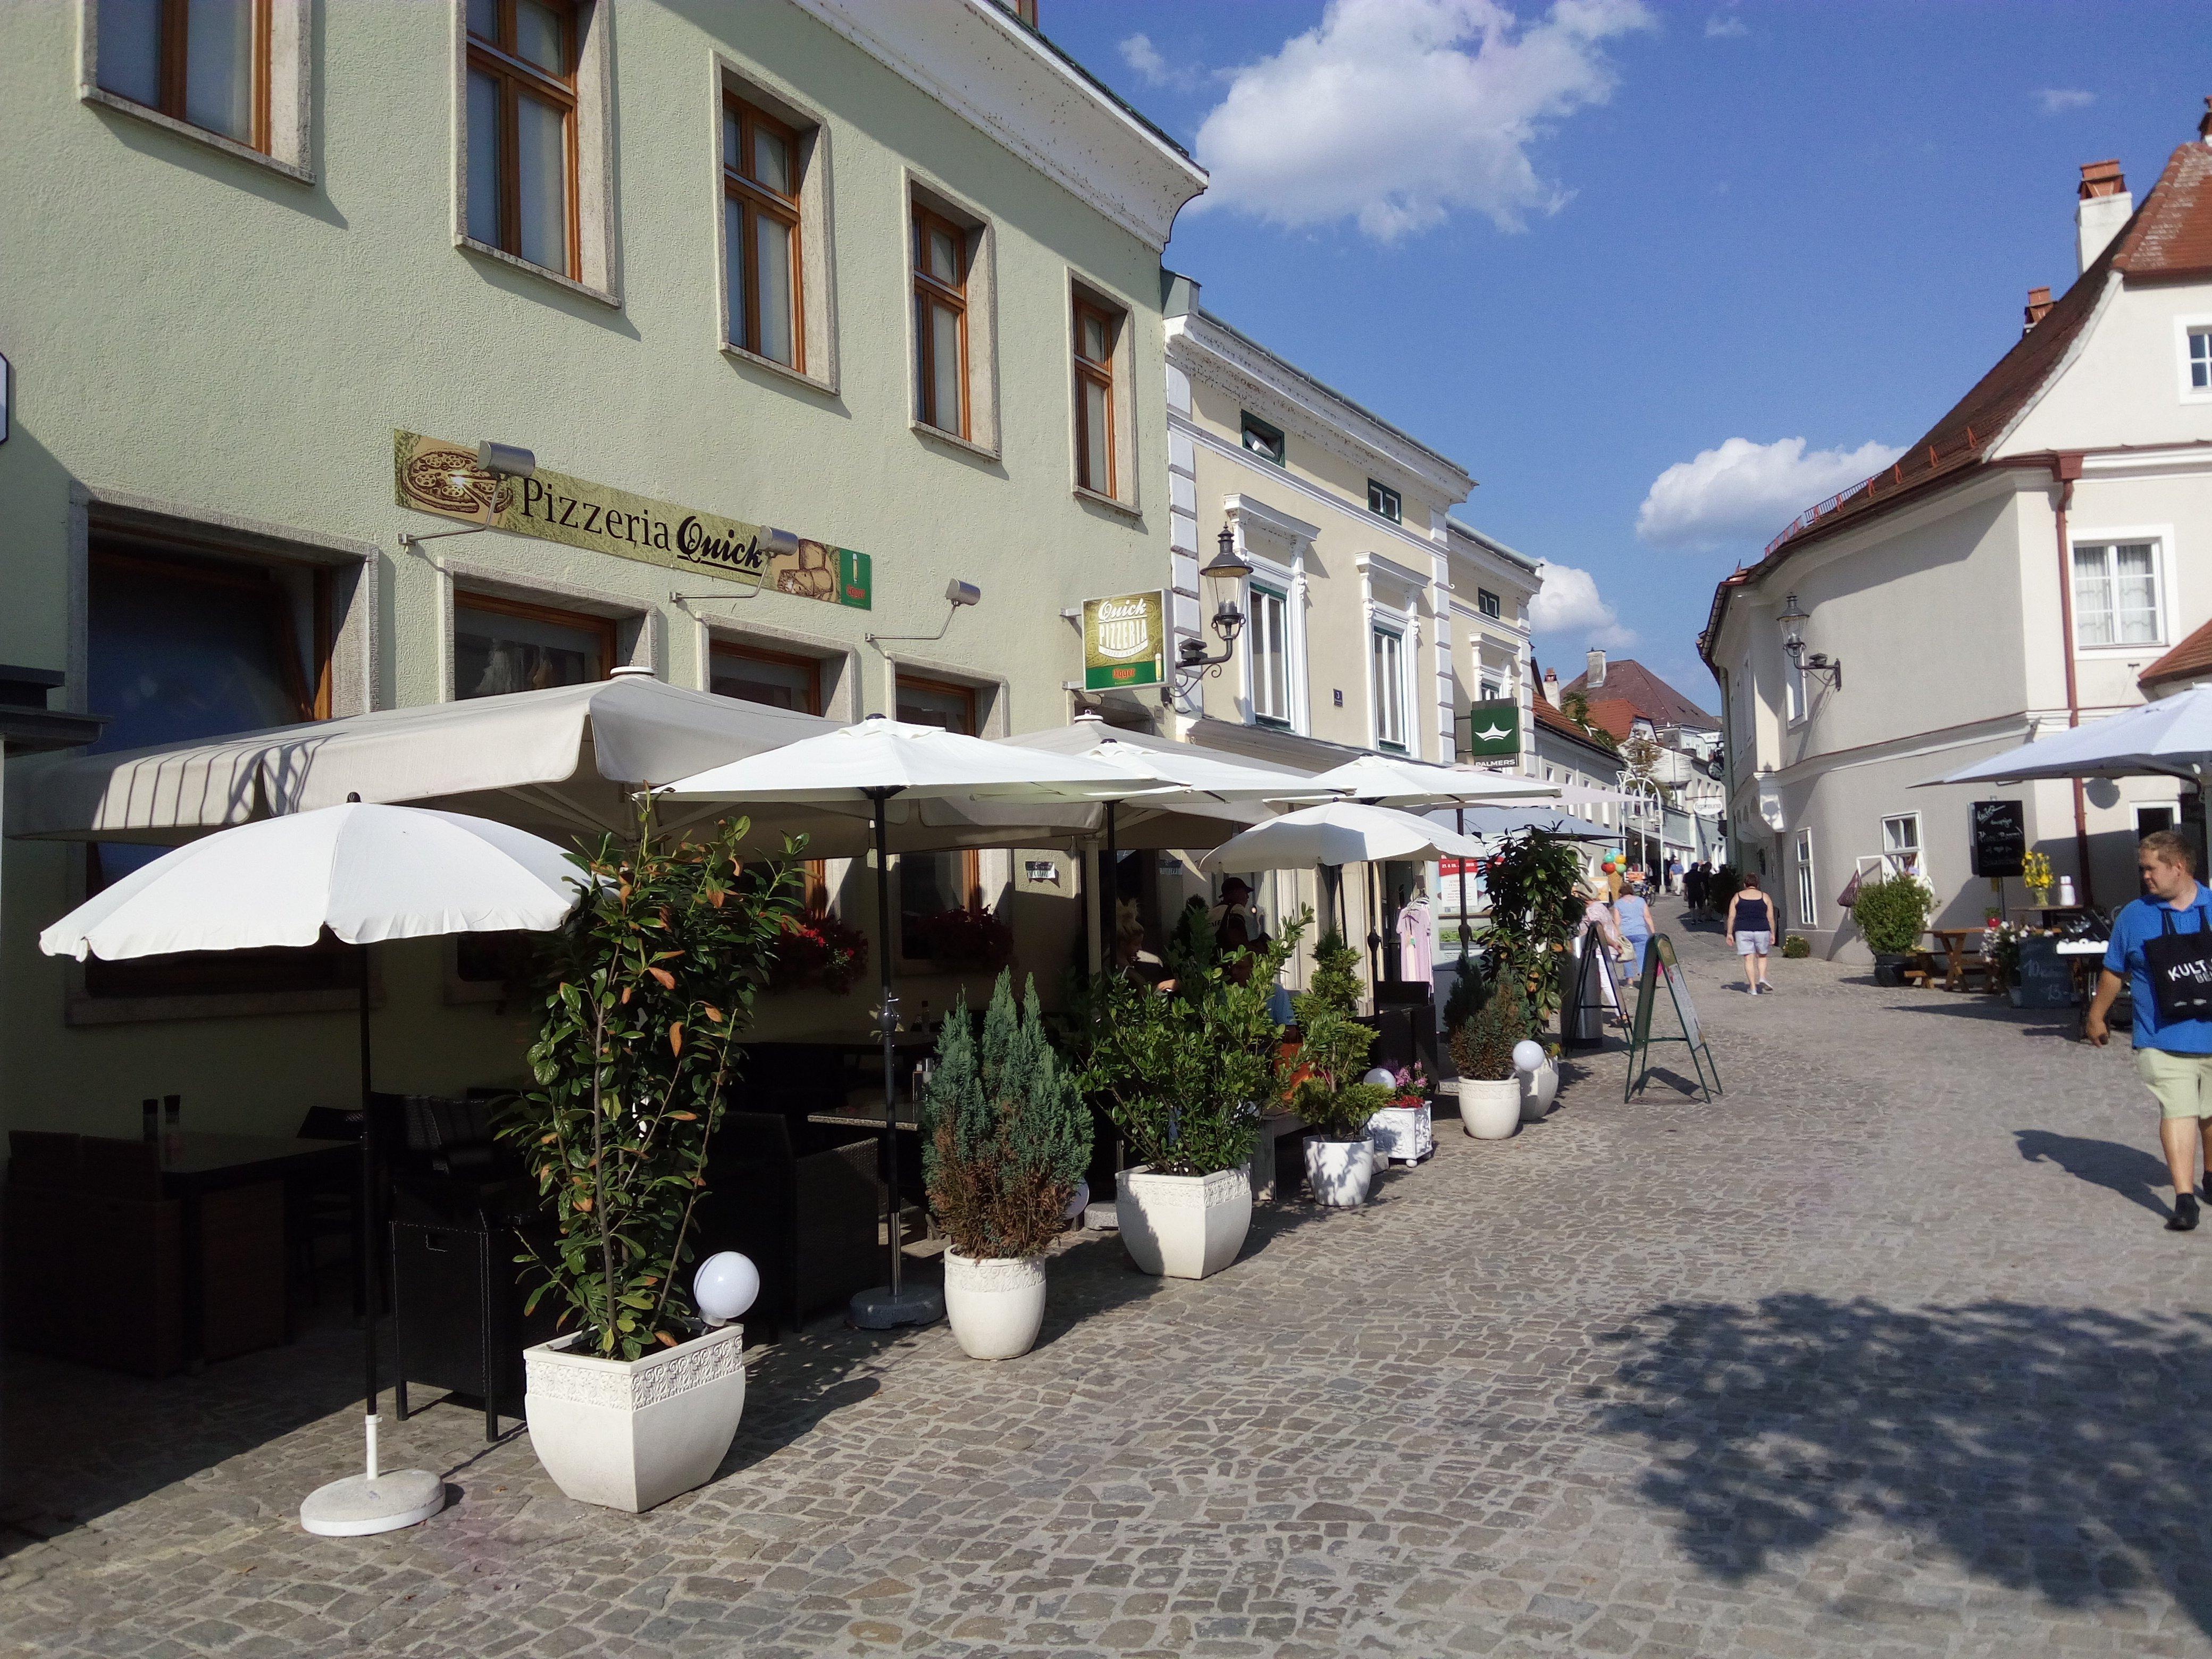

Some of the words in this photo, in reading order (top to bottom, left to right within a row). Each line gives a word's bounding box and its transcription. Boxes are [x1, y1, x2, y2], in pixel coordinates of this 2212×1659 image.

[521, 477, 671, 551] Pizzeria
[677, 516, 763, 568] Quick
[1099, 598, 1146, 622] Quick
[1099, 619, 1147, 650] PIZZERIA
[2168, 959, 2212, 982] KULT
[2194, 970, 2212, 984] BE
